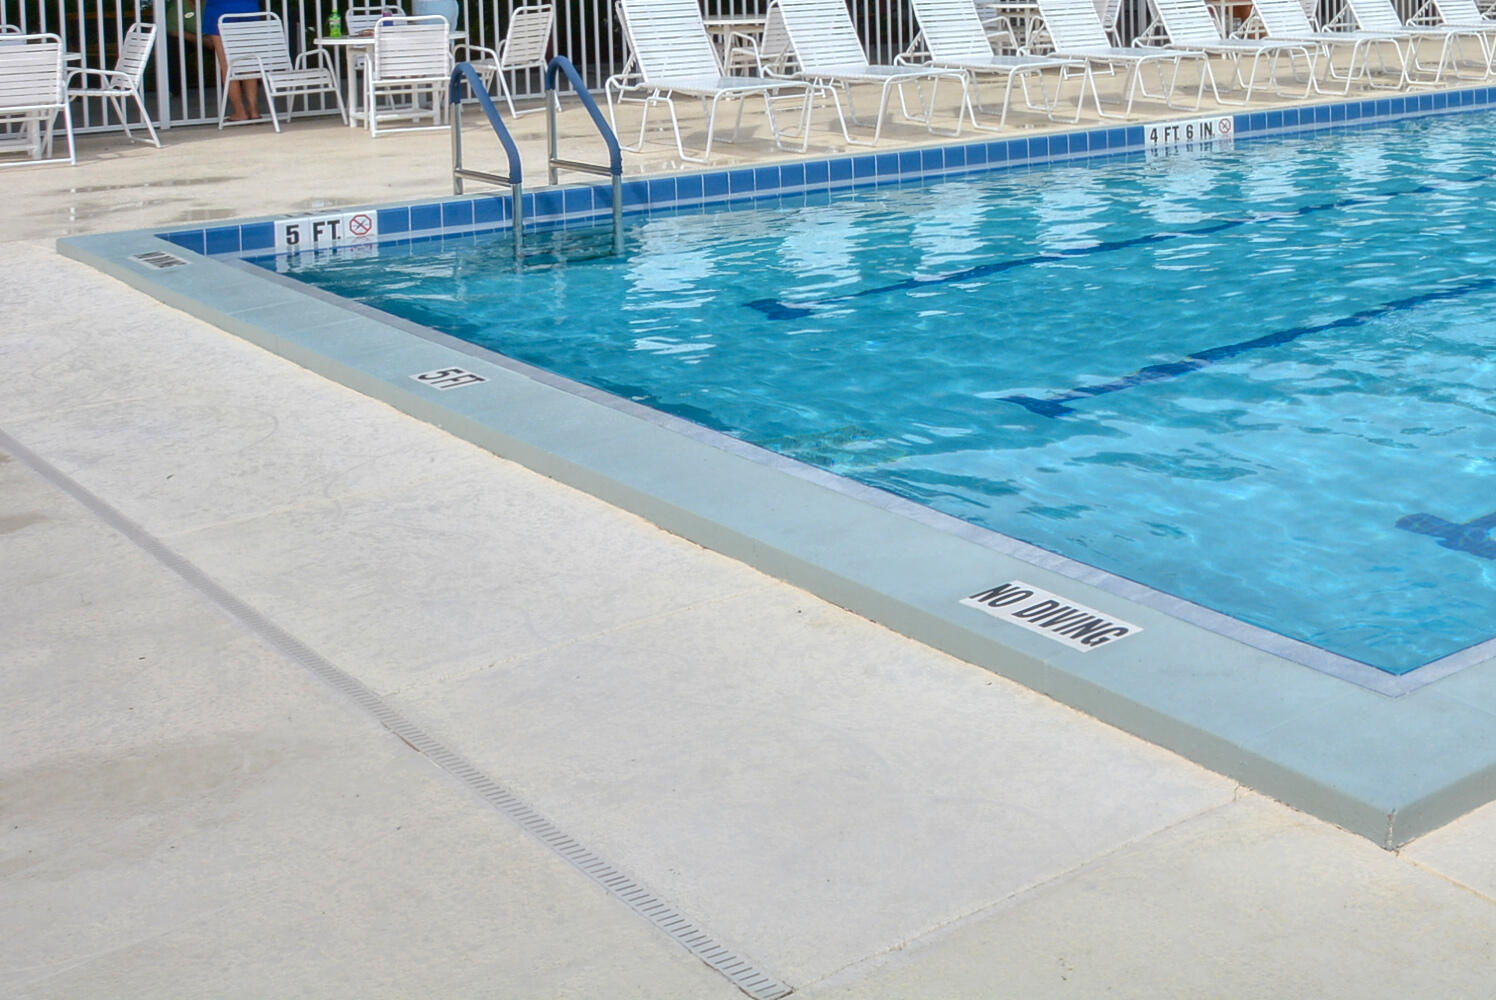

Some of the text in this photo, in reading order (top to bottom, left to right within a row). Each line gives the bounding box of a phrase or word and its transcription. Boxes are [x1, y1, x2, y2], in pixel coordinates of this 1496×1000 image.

[1150, 127, 1158, 143] 4
[1164, 125, 1180, 142] FT.
[1186, 124, 1194, 140] 6
[286, 219, 342, 245] 5 FT.
[417, 368, 487, 389] 5 FT
[969, 583, 1129, 647] NO DIVING
